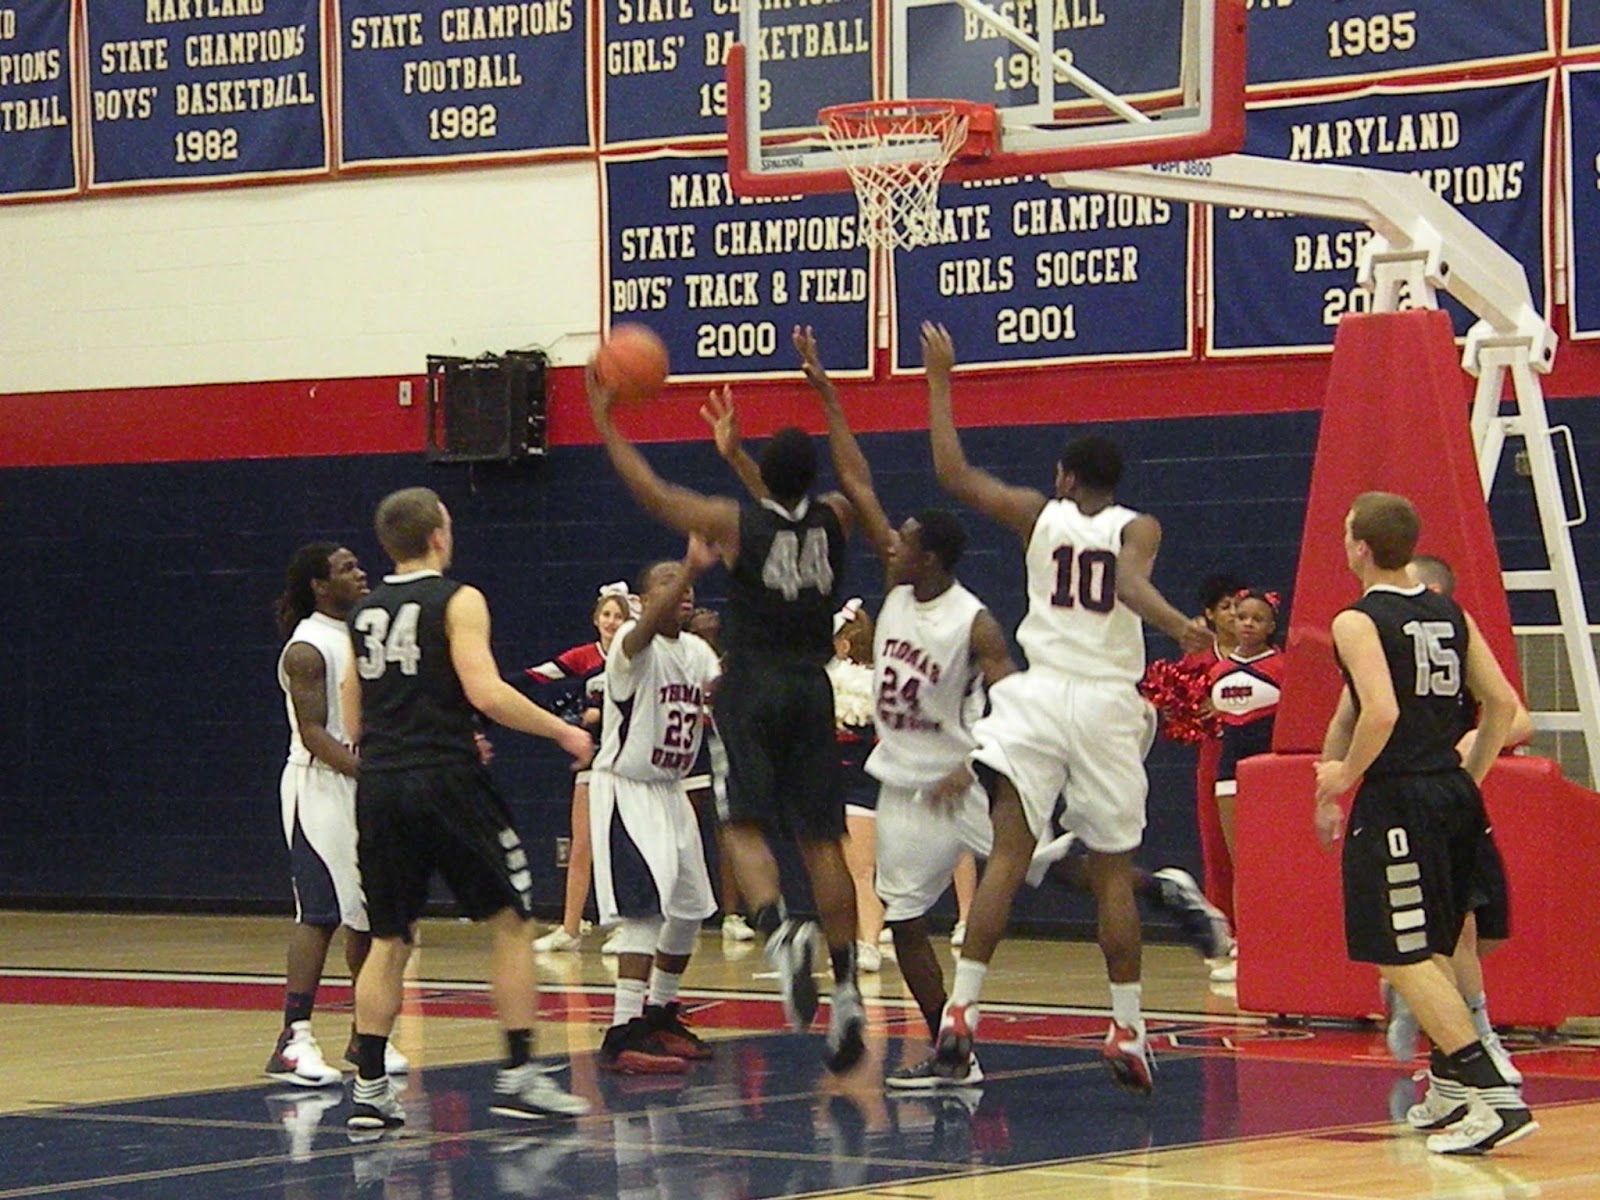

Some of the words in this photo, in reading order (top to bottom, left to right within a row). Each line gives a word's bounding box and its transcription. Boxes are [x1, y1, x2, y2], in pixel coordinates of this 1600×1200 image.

[350, 13, 423, 49] STATE
[440, 0, 573, 43] CHAMPIONS
[618, 0, 693, 25] STATE
[1328, 11, 1417, 58] 1985
[101, 38, 169, 74] STATE
[184, 25, 306, 68] CHAMPIONS
[608, 36, 685, 76] GIRLS'
[705, 18, 869, 66] BAKETBALL
[94, 87, 158, 122] BOYS'
[175, 72, 316, 116] BASKETBALL
[403, 53, 523, 95] FOOTBALL
[174, 128, 239, 164] 1982
[428, 104, 498, 141] 1982
[1288, 111, 1461, 162] MARYLAND
[1012, 192, 1171, 237] CHAMPIONS
[621, 224, 696, 262] STATE
[714, 215, 856, 257] CHAMPIONS
[612, 276, 673, 314] BOYS'
[684, 272, 760, 309] TRACK
[772, 270, 789, 305] &
[799, 267, 867, 303] FIELD
[939, 256, 1015, 296] GIRLS
[1036, 245, 1139, 289] SOCCER
[696, 321, 777, 359] 2000
[996, 304, 1077, 344] 2001
[1050, 544, 1117, 614] 10
[354, 602, 422, 680] 34
[1402, 620, 1461, 697] 15
[879, 666, 920, 713] 24
[663, 710, 698, 751] 23
